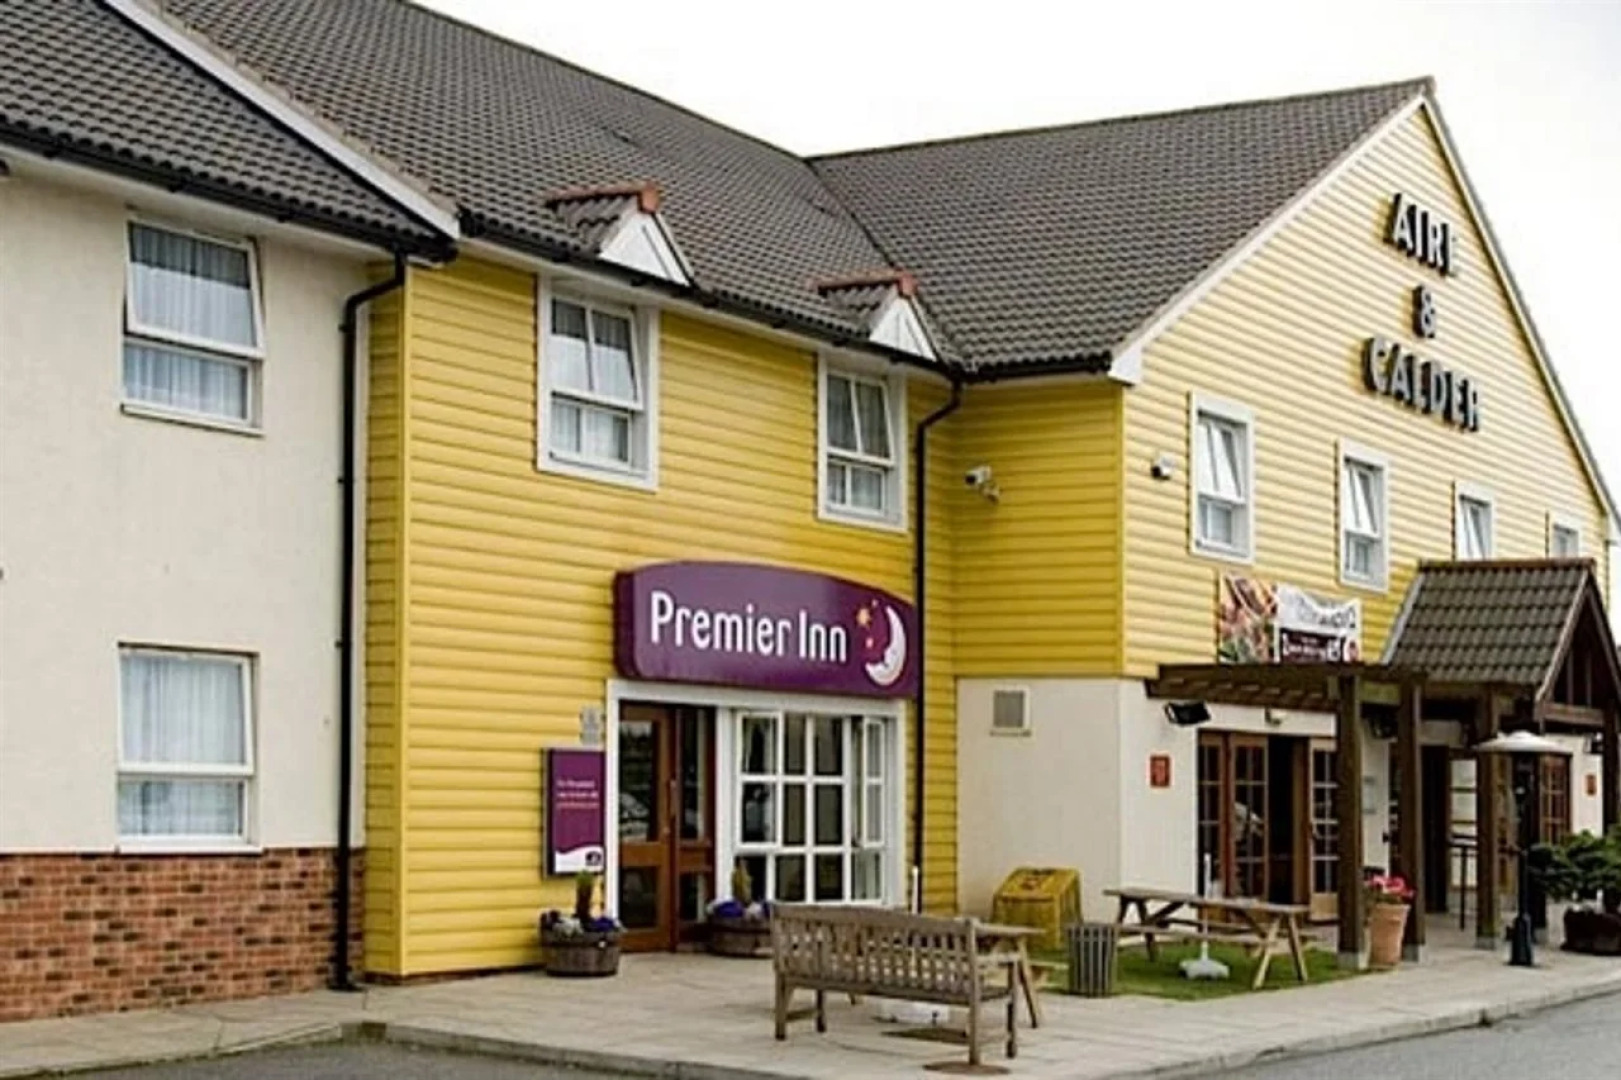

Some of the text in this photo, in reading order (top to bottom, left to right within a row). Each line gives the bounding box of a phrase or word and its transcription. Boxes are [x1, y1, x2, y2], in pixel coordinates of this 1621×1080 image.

[1413, 284, 1435, 338] &
[1362, 337, 1479, 432] CALDER
[651, 590, 847, 663] Premier Inn
